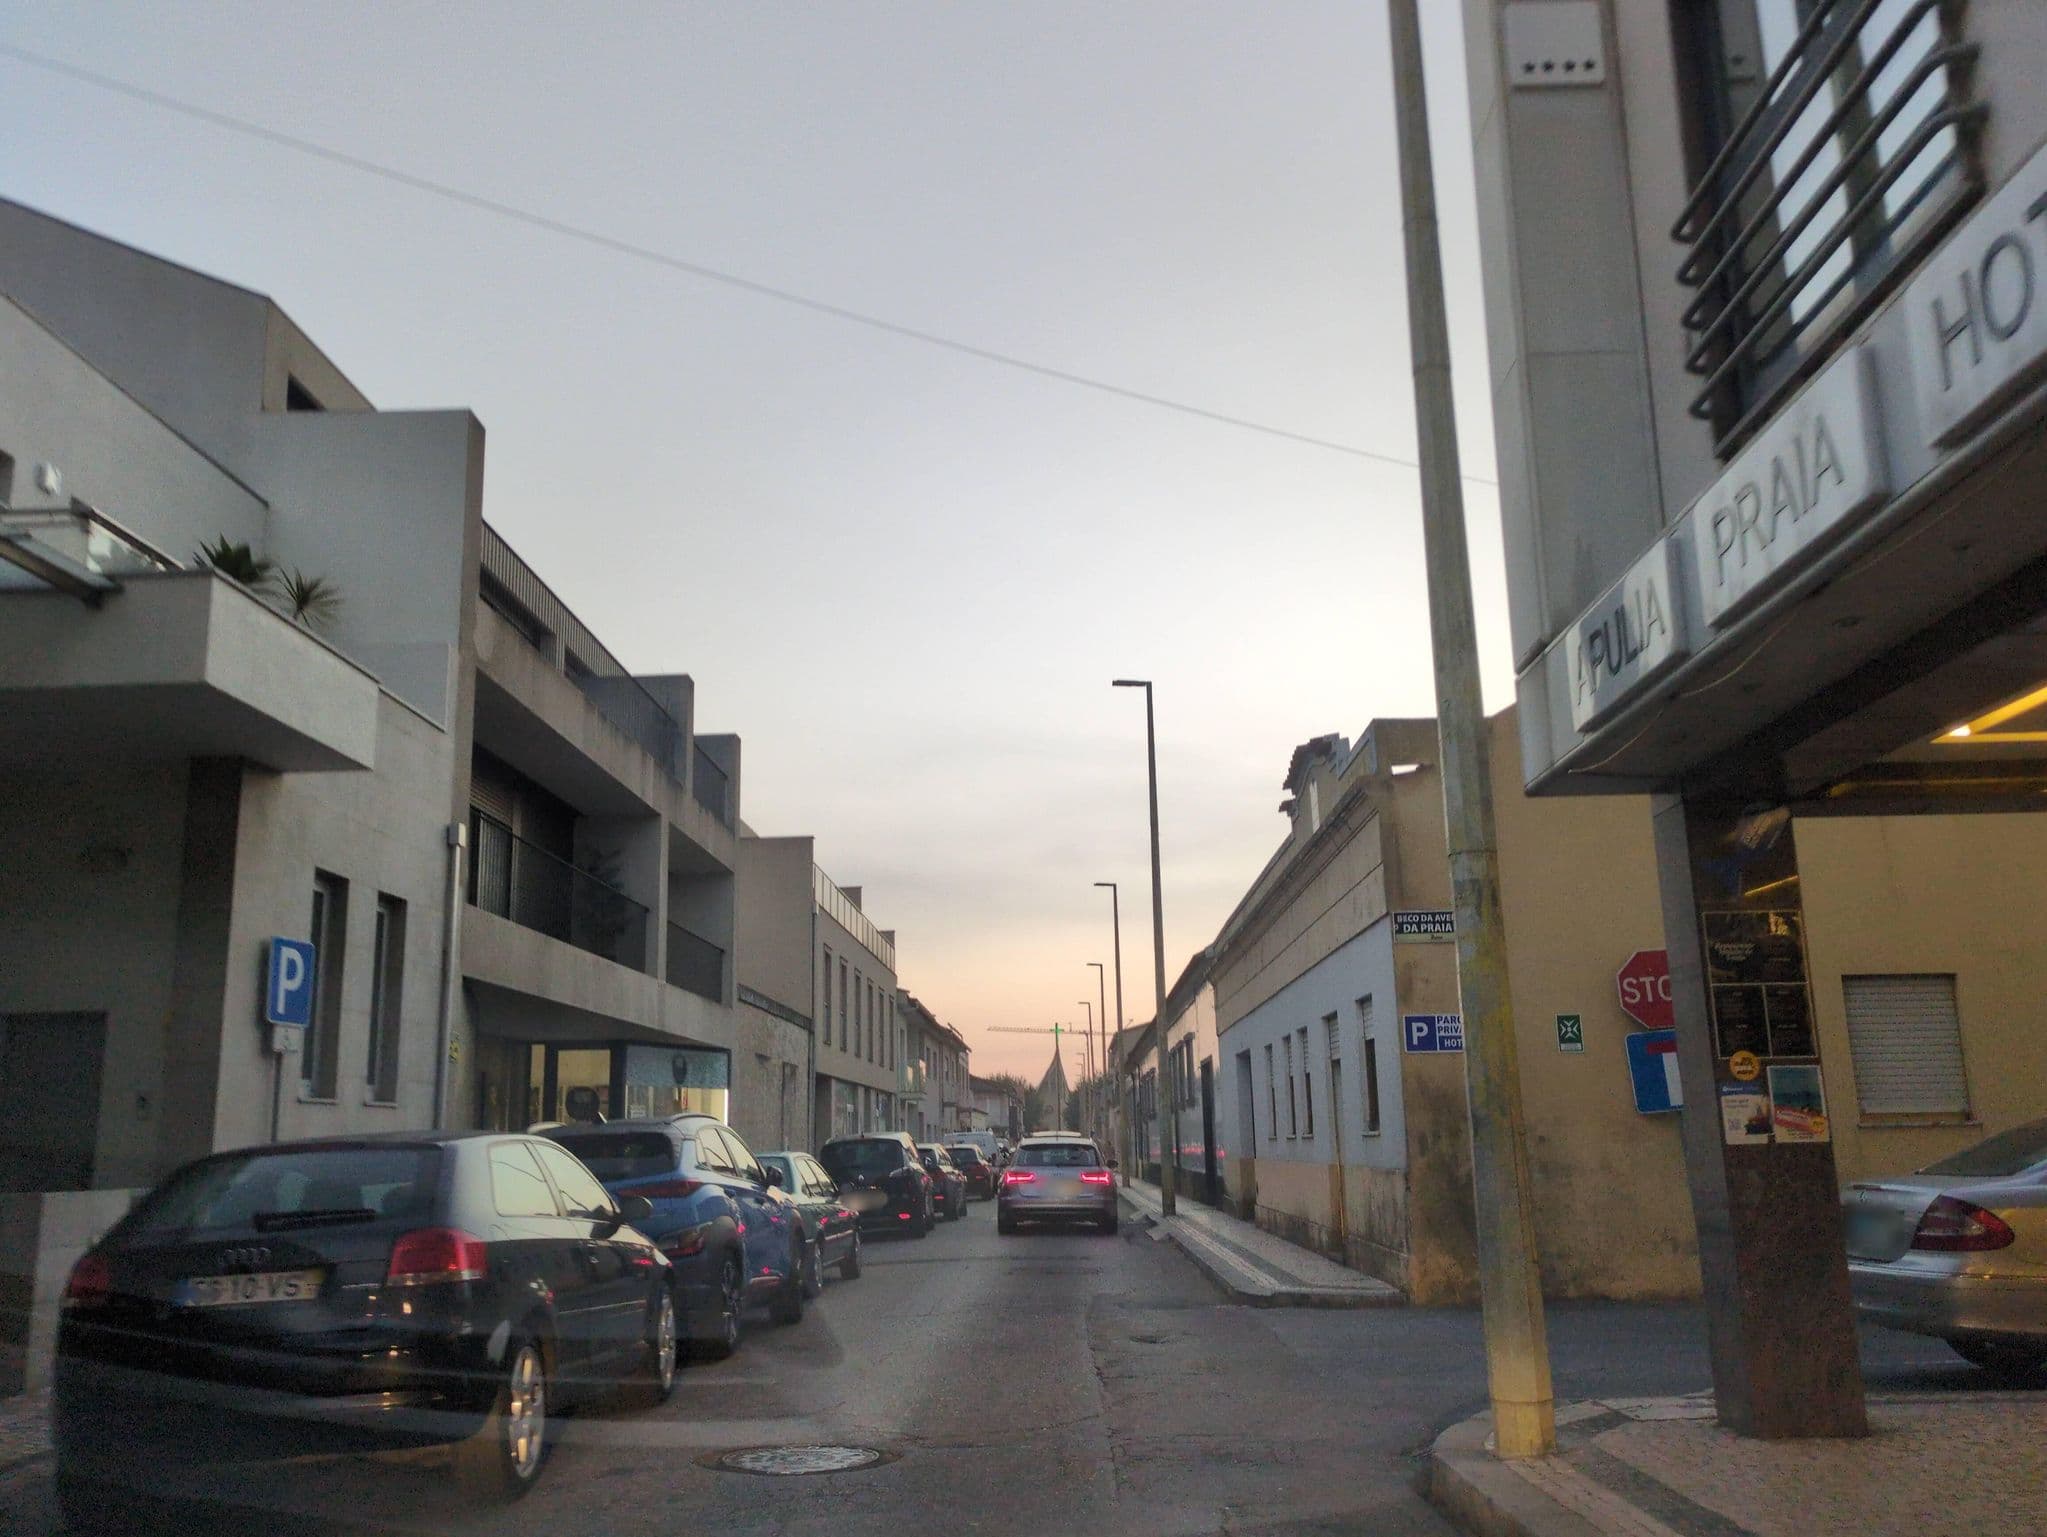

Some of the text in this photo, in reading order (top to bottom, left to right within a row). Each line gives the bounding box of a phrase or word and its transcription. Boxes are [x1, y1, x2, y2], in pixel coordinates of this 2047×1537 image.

[1576, 577, 1666, 706] APULIA
[1711, 414, 1845, 587] PRAIA
[1397, 913, 1419, 923] BECO
[1420, 914, 1433, 923] DA
[1403, 922, 1453, 933] DA PRAIA
[276, 946, 305, 1015] P
[1411, 1022, 1430, 1046] P
[1437, 1025, 1462, 1035] PRIV
